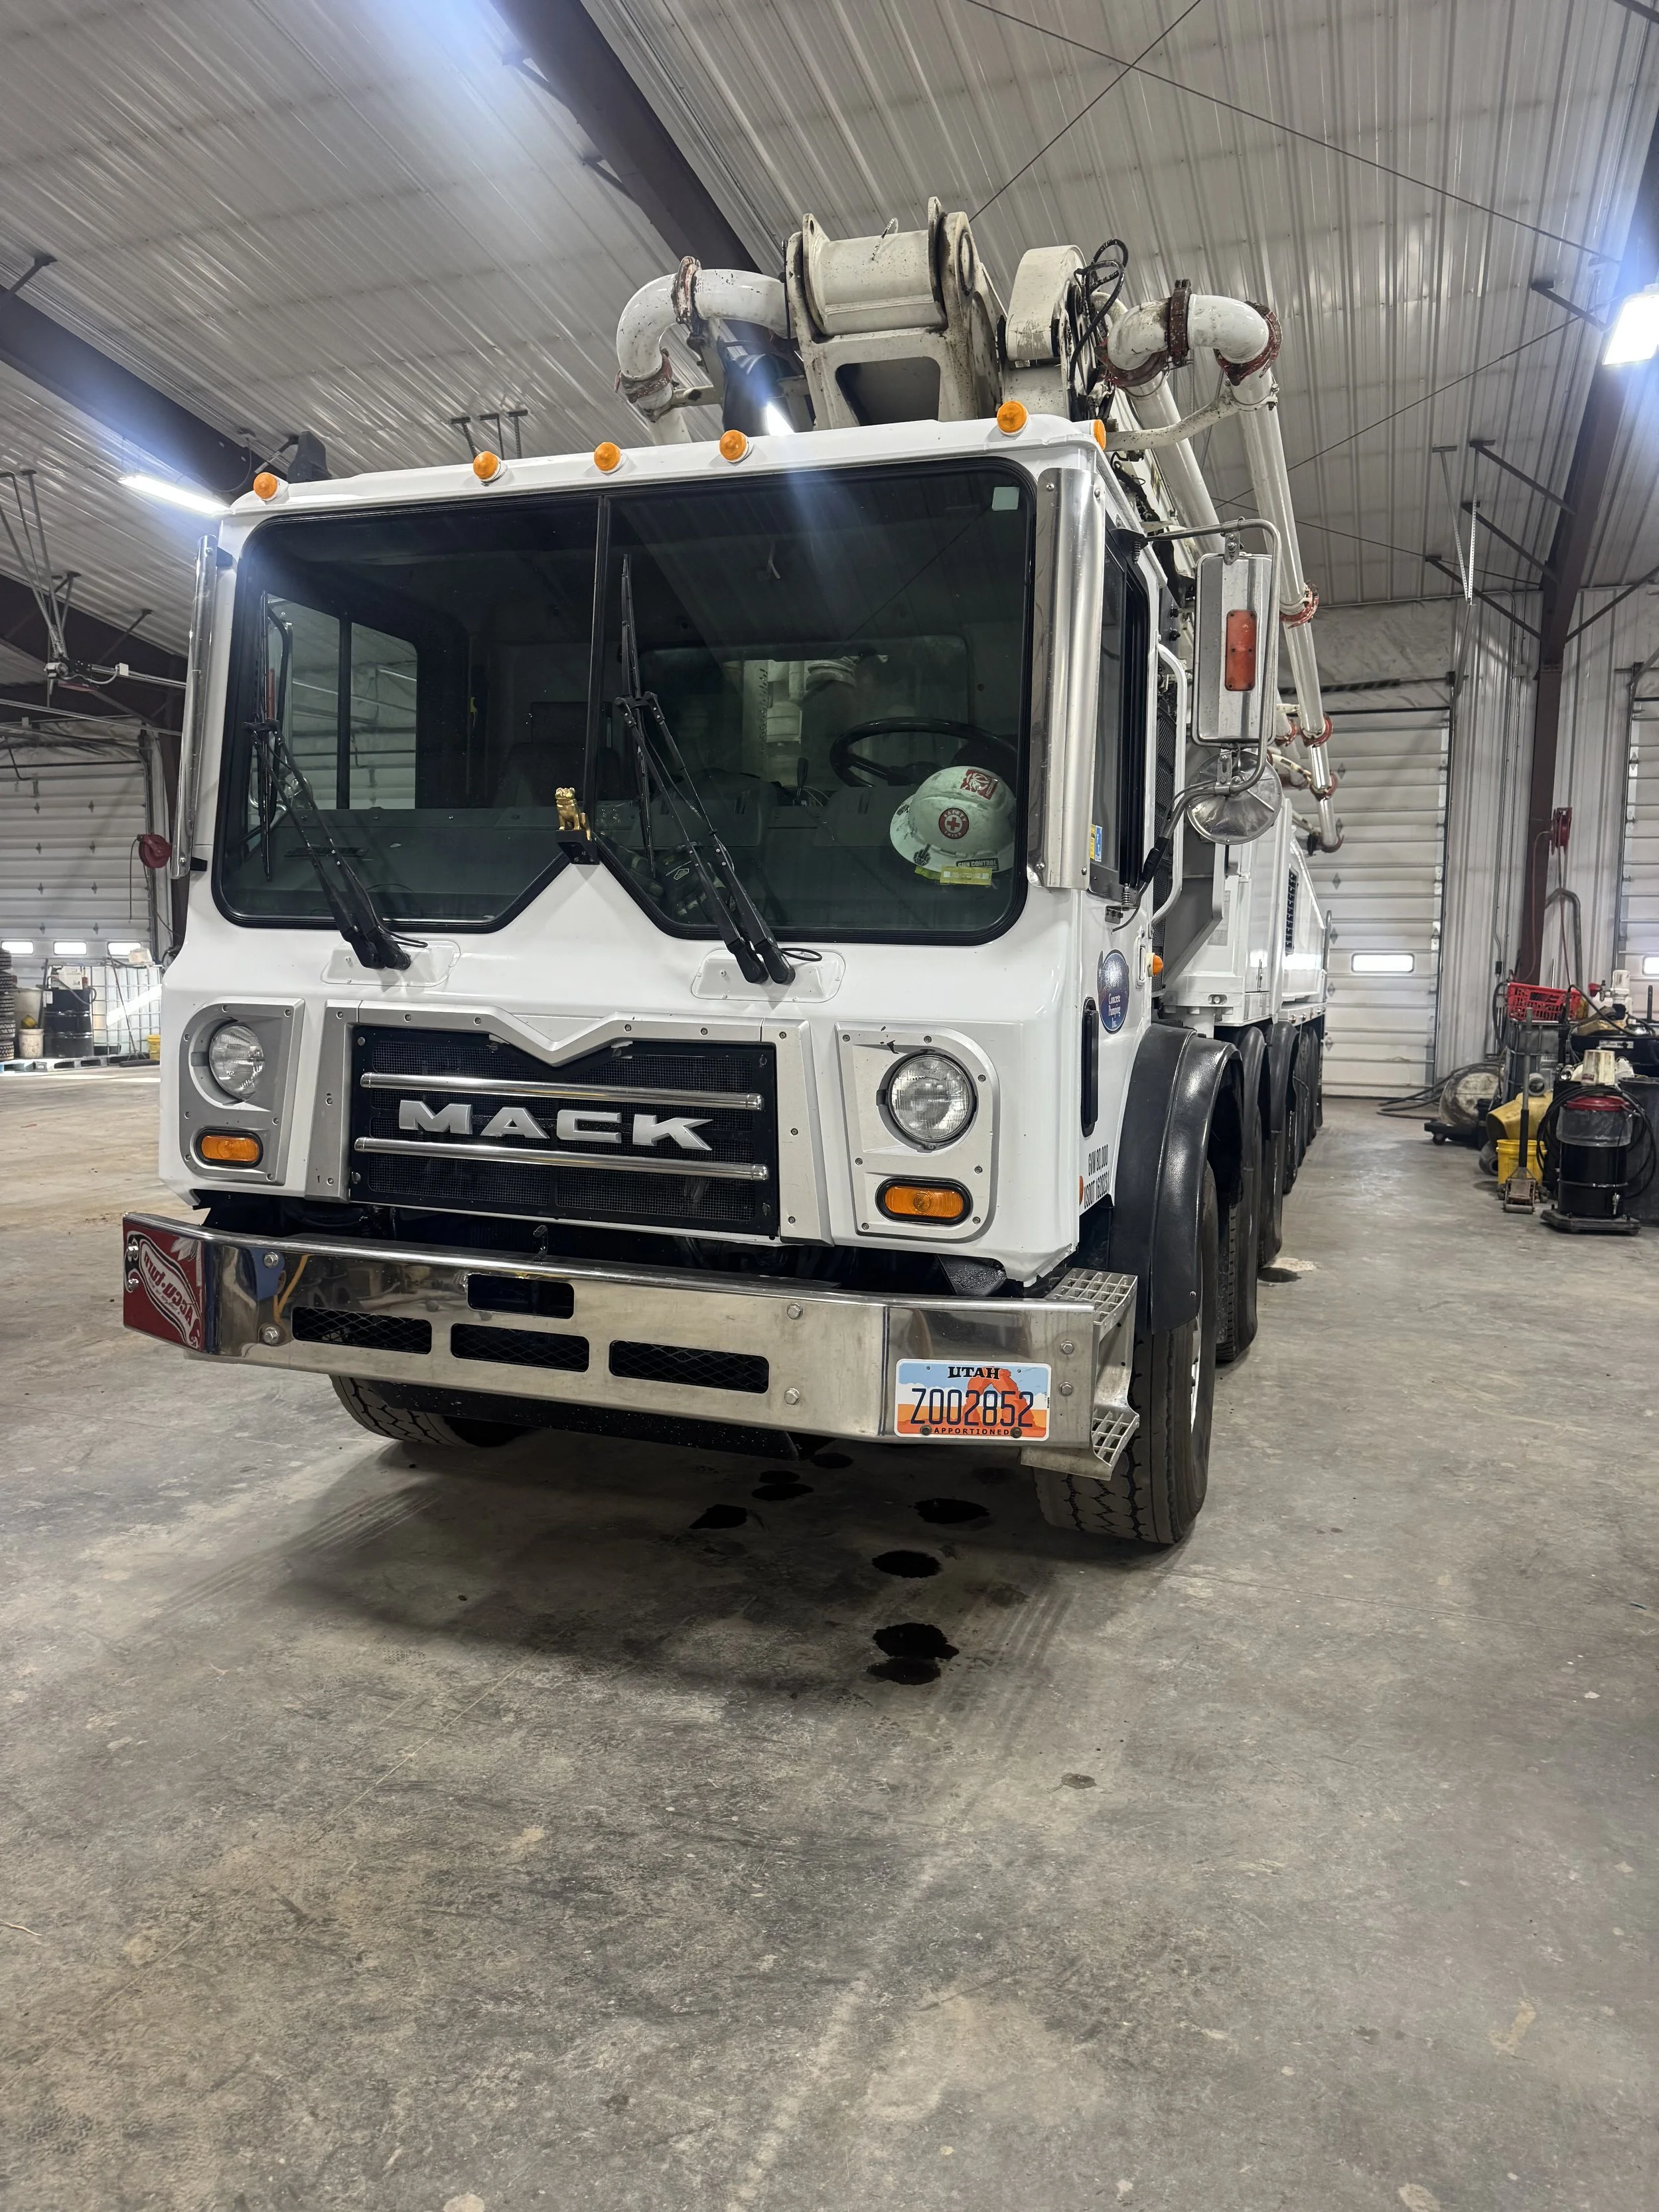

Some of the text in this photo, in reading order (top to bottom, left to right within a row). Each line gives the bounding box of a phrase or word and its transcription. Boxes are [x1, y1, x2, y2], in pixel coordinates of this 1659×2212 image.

[944, 810, 967, 822] SAFETY
[1108, 994, 1121, 1005] Concrete
[1108, 1005, 1121, 1018] Pumping
[399, 1100, 713, 1151] MACK
[1084, 1179, 1095, 1209] USDOT
[948, 1366, 1000, 1379] UTAH
[910, 1388, 1034, 1428] Z002852
[934, 1427, 1010, 1436] APPORTIONED
